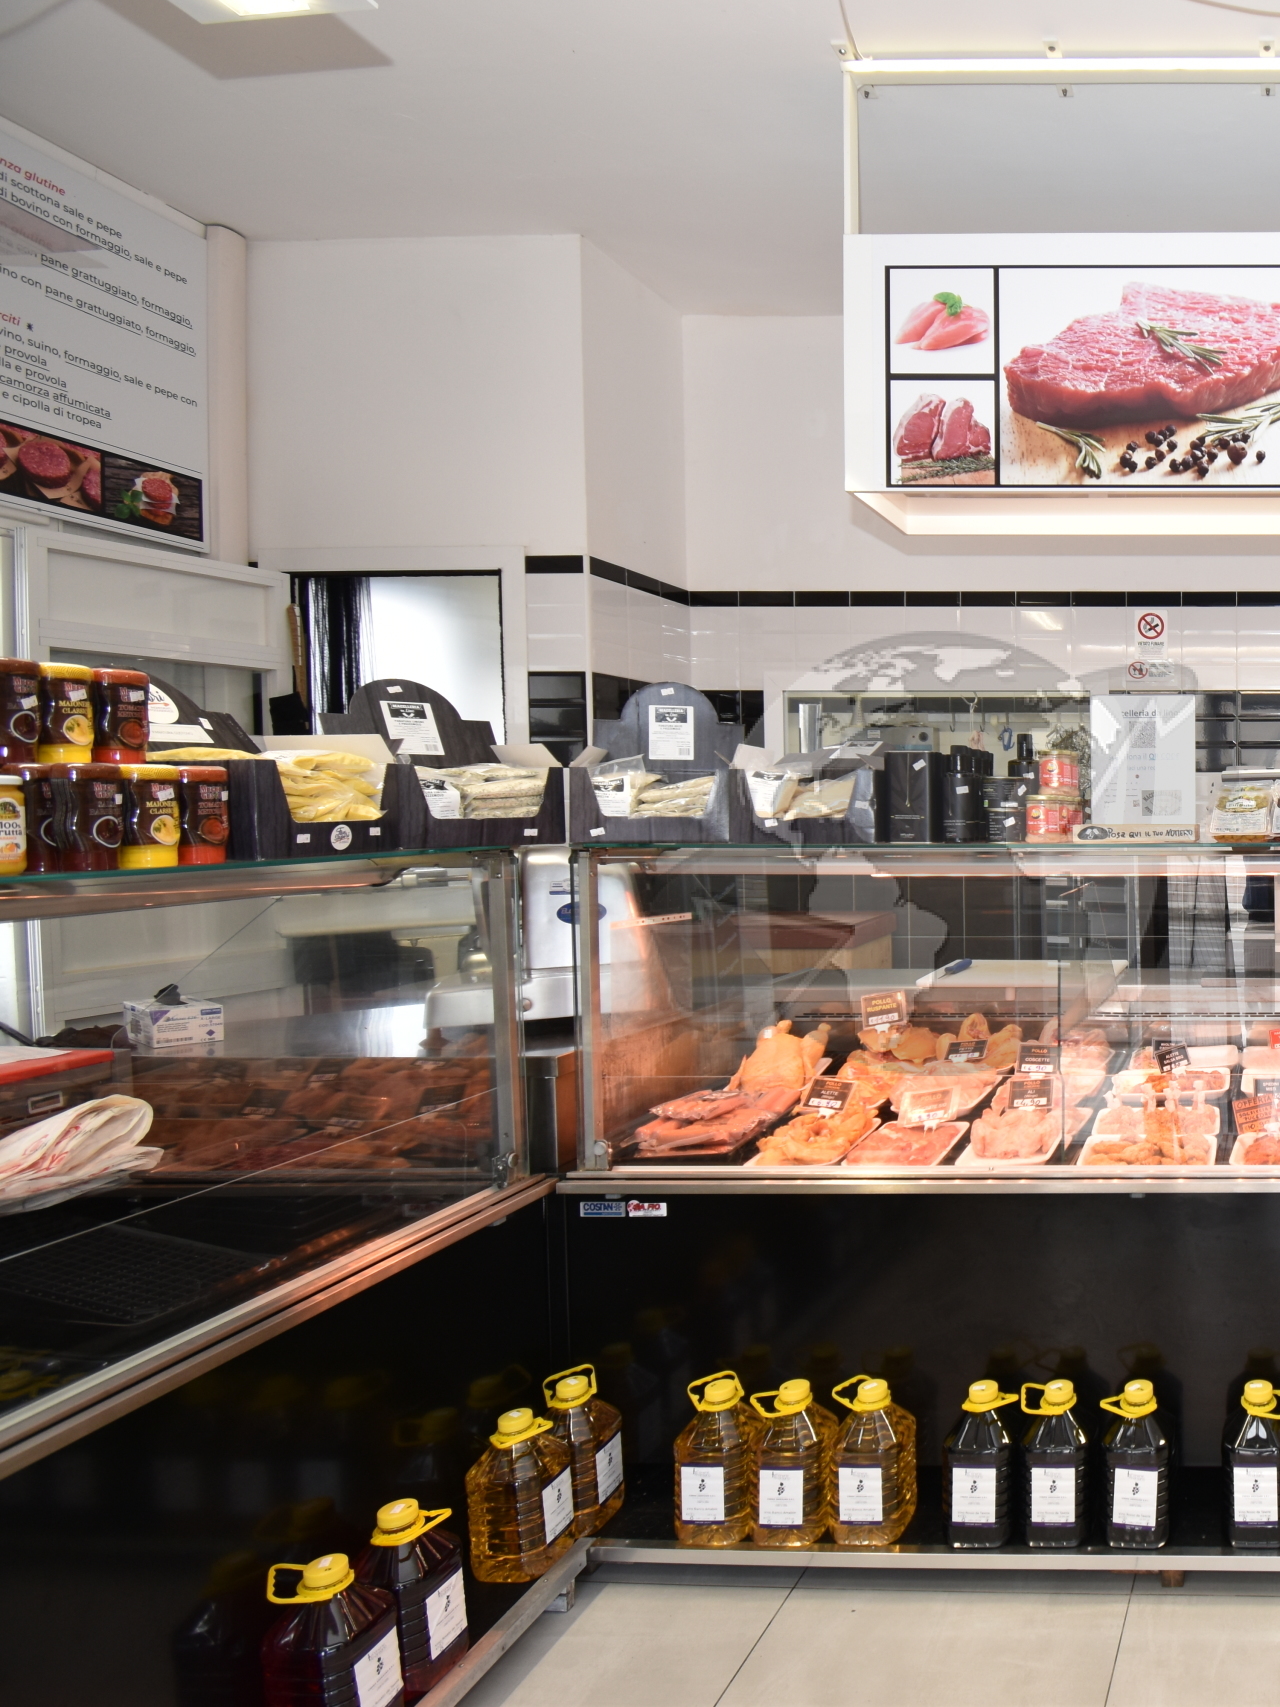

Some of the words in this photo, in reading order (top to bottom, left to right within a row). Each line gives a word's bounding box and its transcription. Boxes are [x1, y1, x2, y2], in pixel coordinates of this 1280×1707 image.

[24, 171, 66, 196] glutine
[11, 179, 60, 209] scottona
[63, 204, 84, 221] sale
[87, 217, 94, 225] e
[96, 221, 122, 239] pepe
[11, 192, 50, 218] bovino
[53, 214, 73, 230] con
[76, 223, 132, 260] formaggio,
[134, 253, 153, 268] sale
[156, 264, 162, 272] e
[164, 268, 187, 285] pepe
[40, 254, 69, 273] pane
[141, 297, 193, 328] formaggio,
[21, 275, 42, 290] con
[45, 285, 73, 303] pane
[145, 326, 197, 356] formaggio,
[4, 345, 47, 368] provola
[27, 338, 62, 358] suino,
[64, 351, 122, 381] formaggio,
[124, 373, 143, 387] sale
[146, 382, 152, 390] e
[154, 385, 179, 401] pepe
[181, 395, 198, 407] con
[15, 364, 22, 372] e
[25, 367, 67, 389] provola
[2, 390, 9, 399] e
[13, 394, 50, 412] cipolla
[54, 406, 64, 416] di
[66, 409, 102, 429] tropea
[53, 391, 111, 418] affumicata
[867, 1003, 897, 1012] RUSPANTE
[583, 1203, 613, 1211] COSTAN
